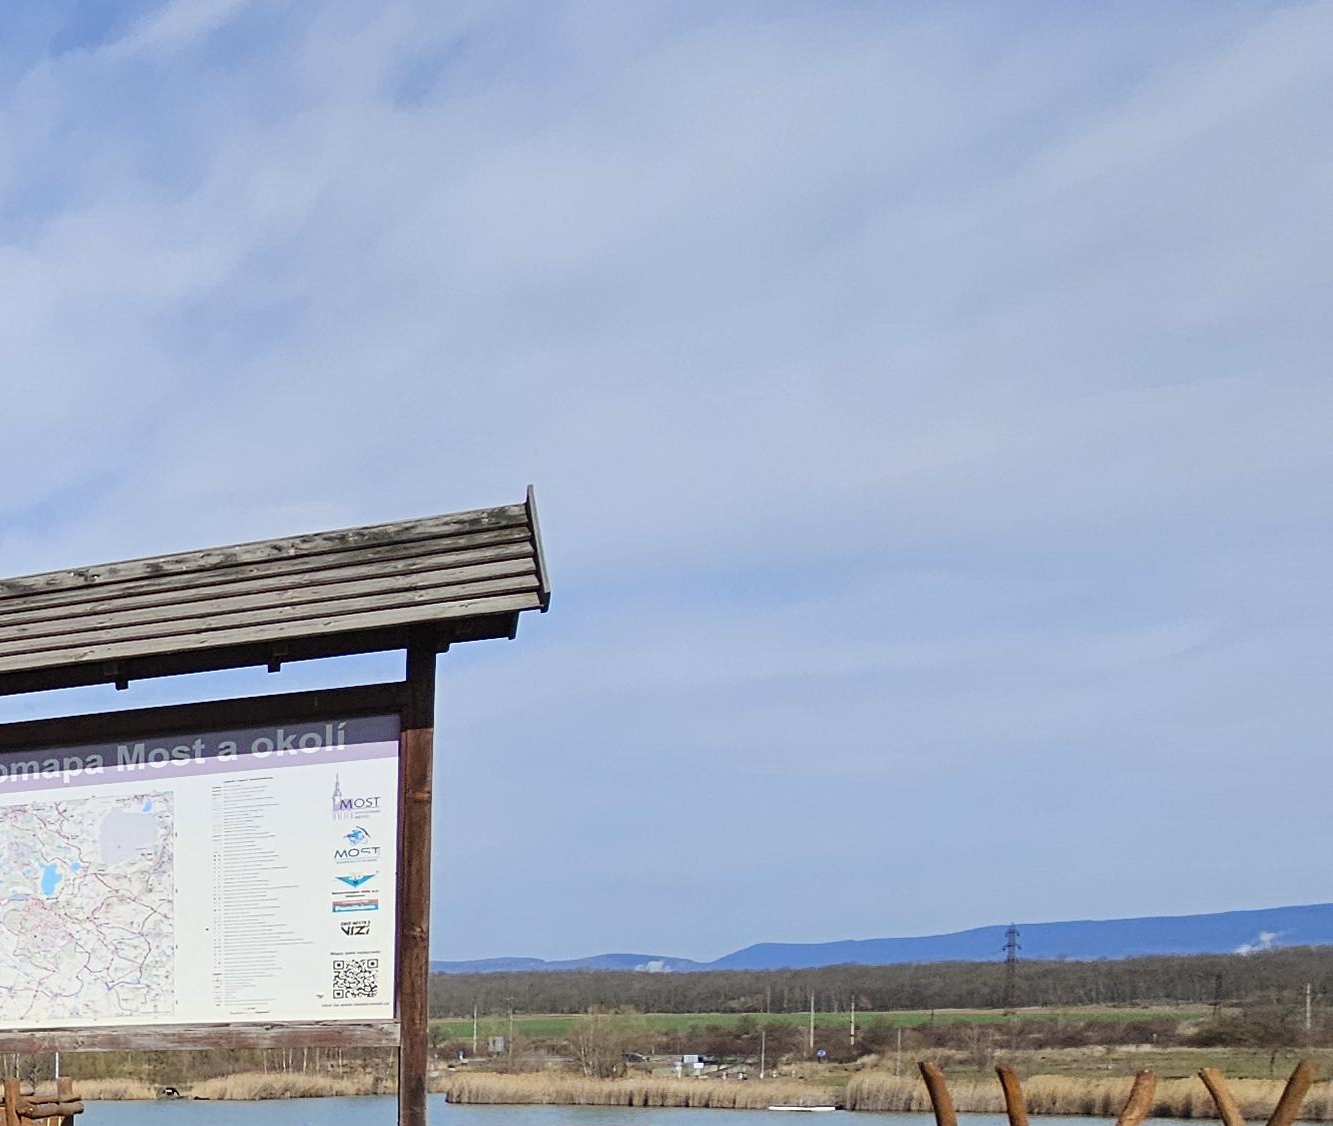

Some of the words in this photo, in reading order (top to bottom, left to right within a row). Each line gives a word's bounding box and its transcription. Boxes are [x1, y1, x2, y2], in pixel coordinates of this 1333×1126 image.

[117, 738, 206, 772] Most
[217, 740, 238, 762] a
[251, 722, 347, 758] okolí
[339, 796, 381, 810] MOST
[334, 847, 380, 859] MOST
